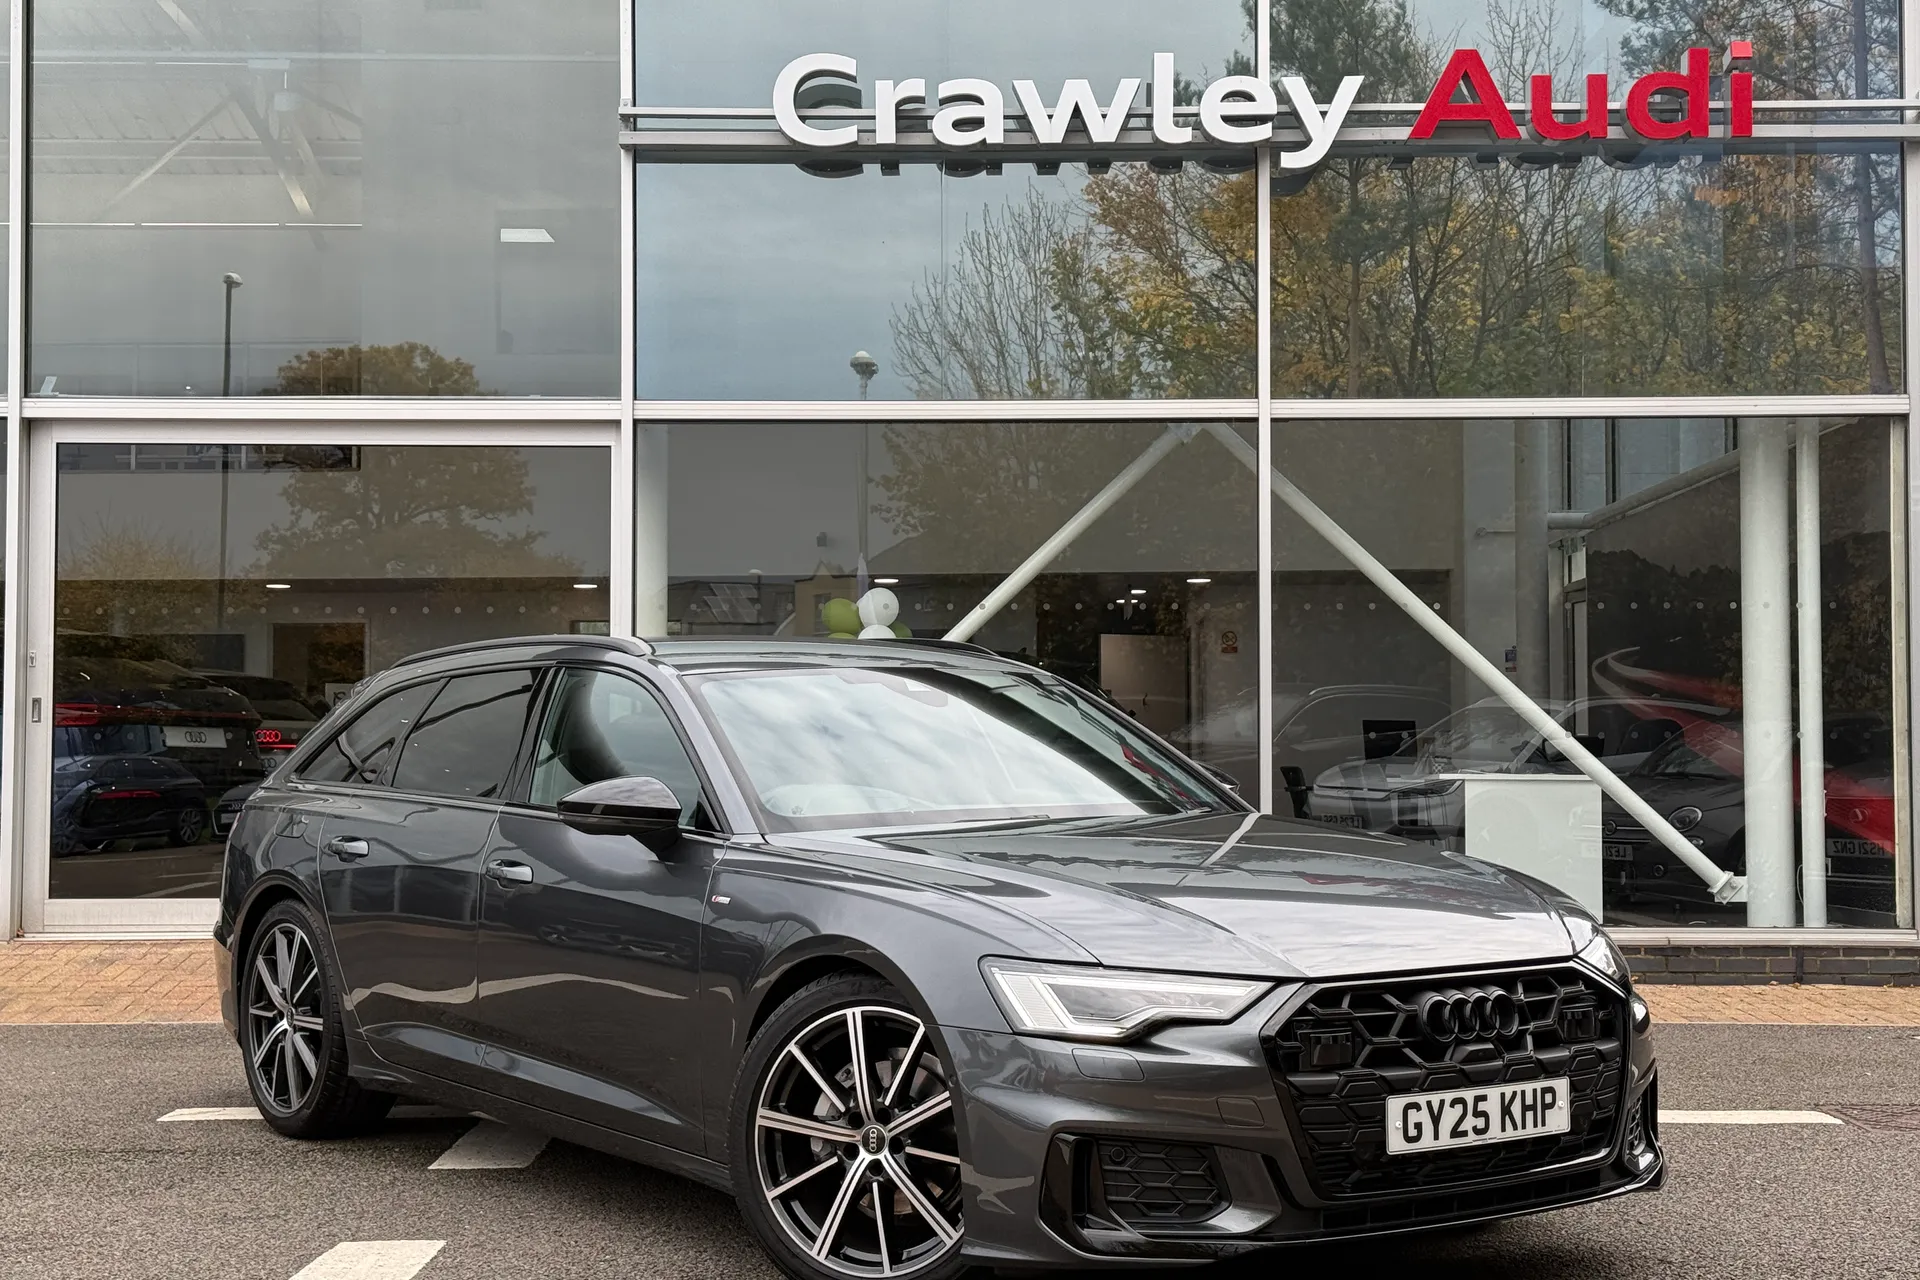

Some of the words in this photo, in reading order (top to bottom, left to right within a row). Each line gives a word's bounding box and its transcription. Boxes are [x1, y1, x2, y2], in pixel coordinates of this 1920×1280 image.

[773, 53, 1365, 168] Crawley
[1410, 40, 1754, 140] Audi
[1402, 1094, 1490, 1143] GY25
[1500, 1086, 1557, 1132] KHP
